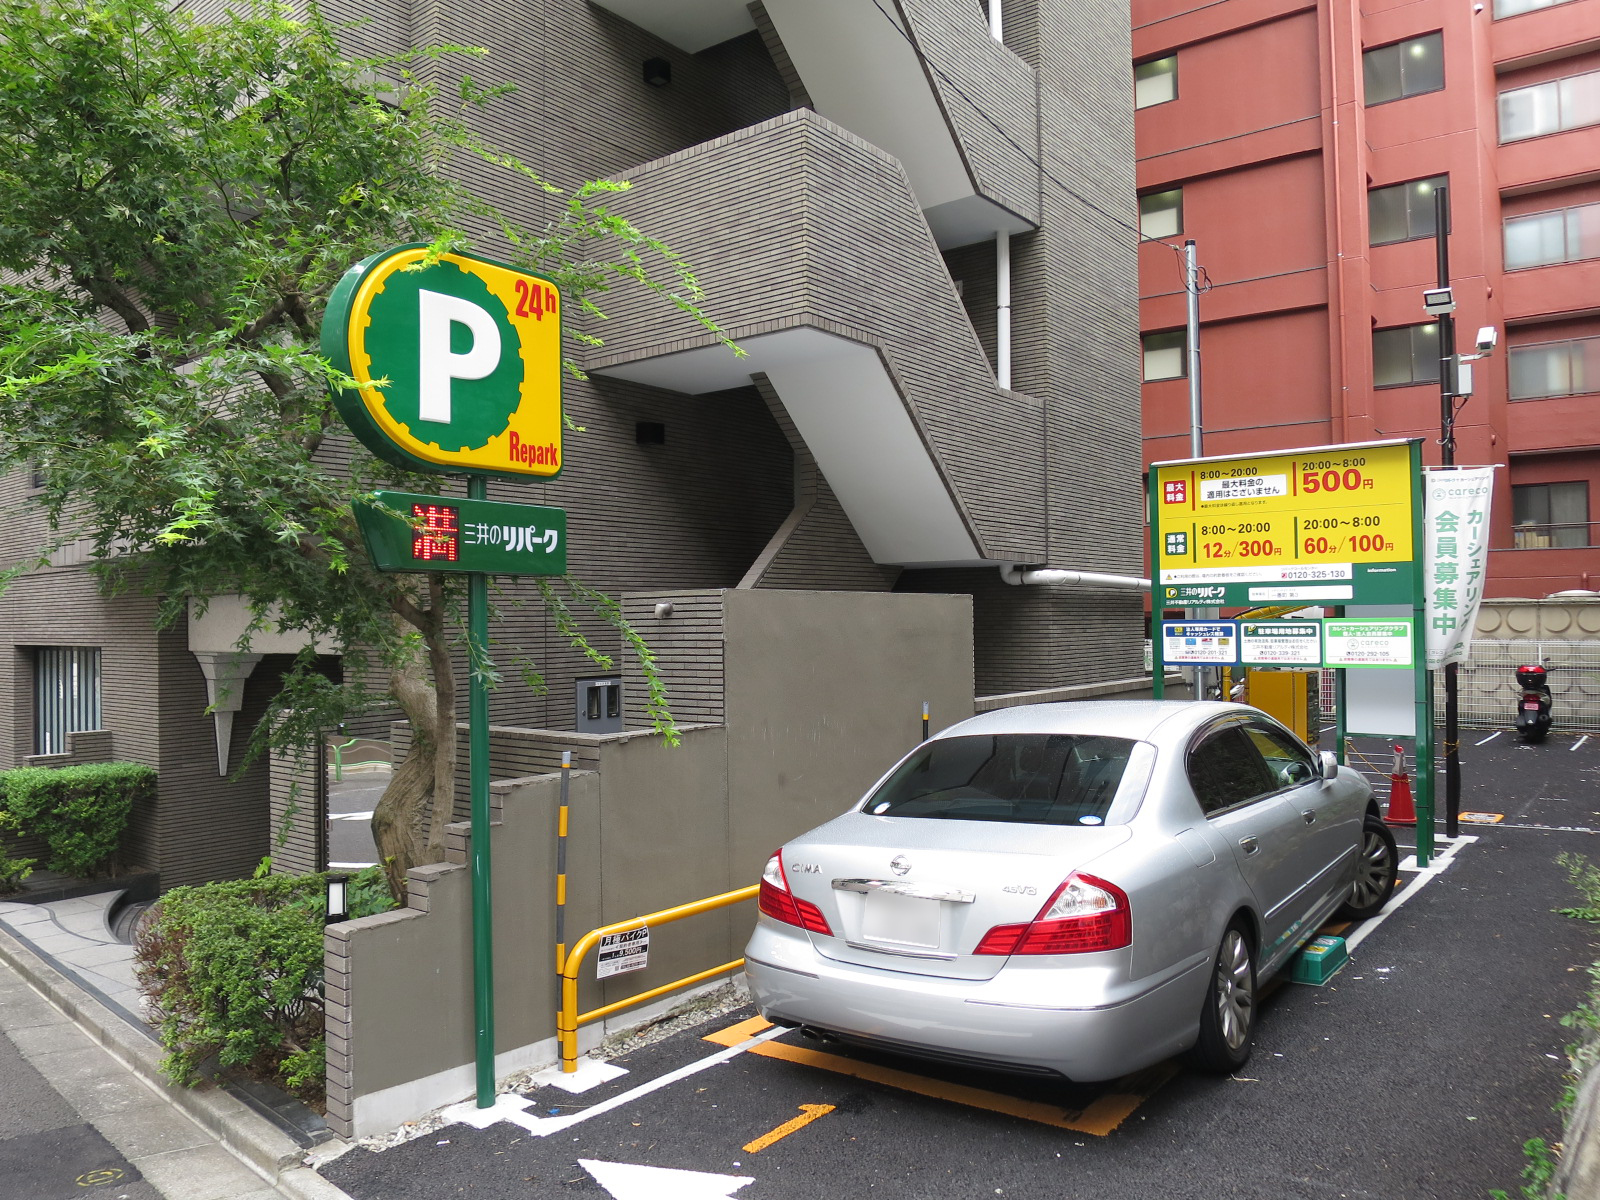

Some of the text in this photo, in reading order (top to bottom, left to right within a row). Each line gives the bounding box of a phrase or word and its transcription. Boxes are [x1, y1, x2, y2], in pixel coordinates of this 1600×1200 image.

[514, 279, 557, 321] 24h
[419, 288, 502, 424] P
[509, 430, 558, 468] Repark
[1221, 478, 1264, 489] 最大料金の
[1302, 468, 1374, 494] 500円
[1166, 483, 1184, 492] 最大
[1207, 486, 1280, 499] 適用はございません
[1448, 487, 1488, 496] careco
[1166, 493, 1184, 502] 料金
[414, 505, 458, 561] 満
[464, 522, 558, 554] 三井のリパーク
[1167, 534, 1185, 544] 通常
[1167, 544, 1185, 554] 料金
[1288, 570, 1345, 579] 0120-325-130
[1432, 510, 1460, 636] 会員募集中
[1180, 586, 1225, 598] 三井のリパーク
[791, 863, 823, 874] CIMA
